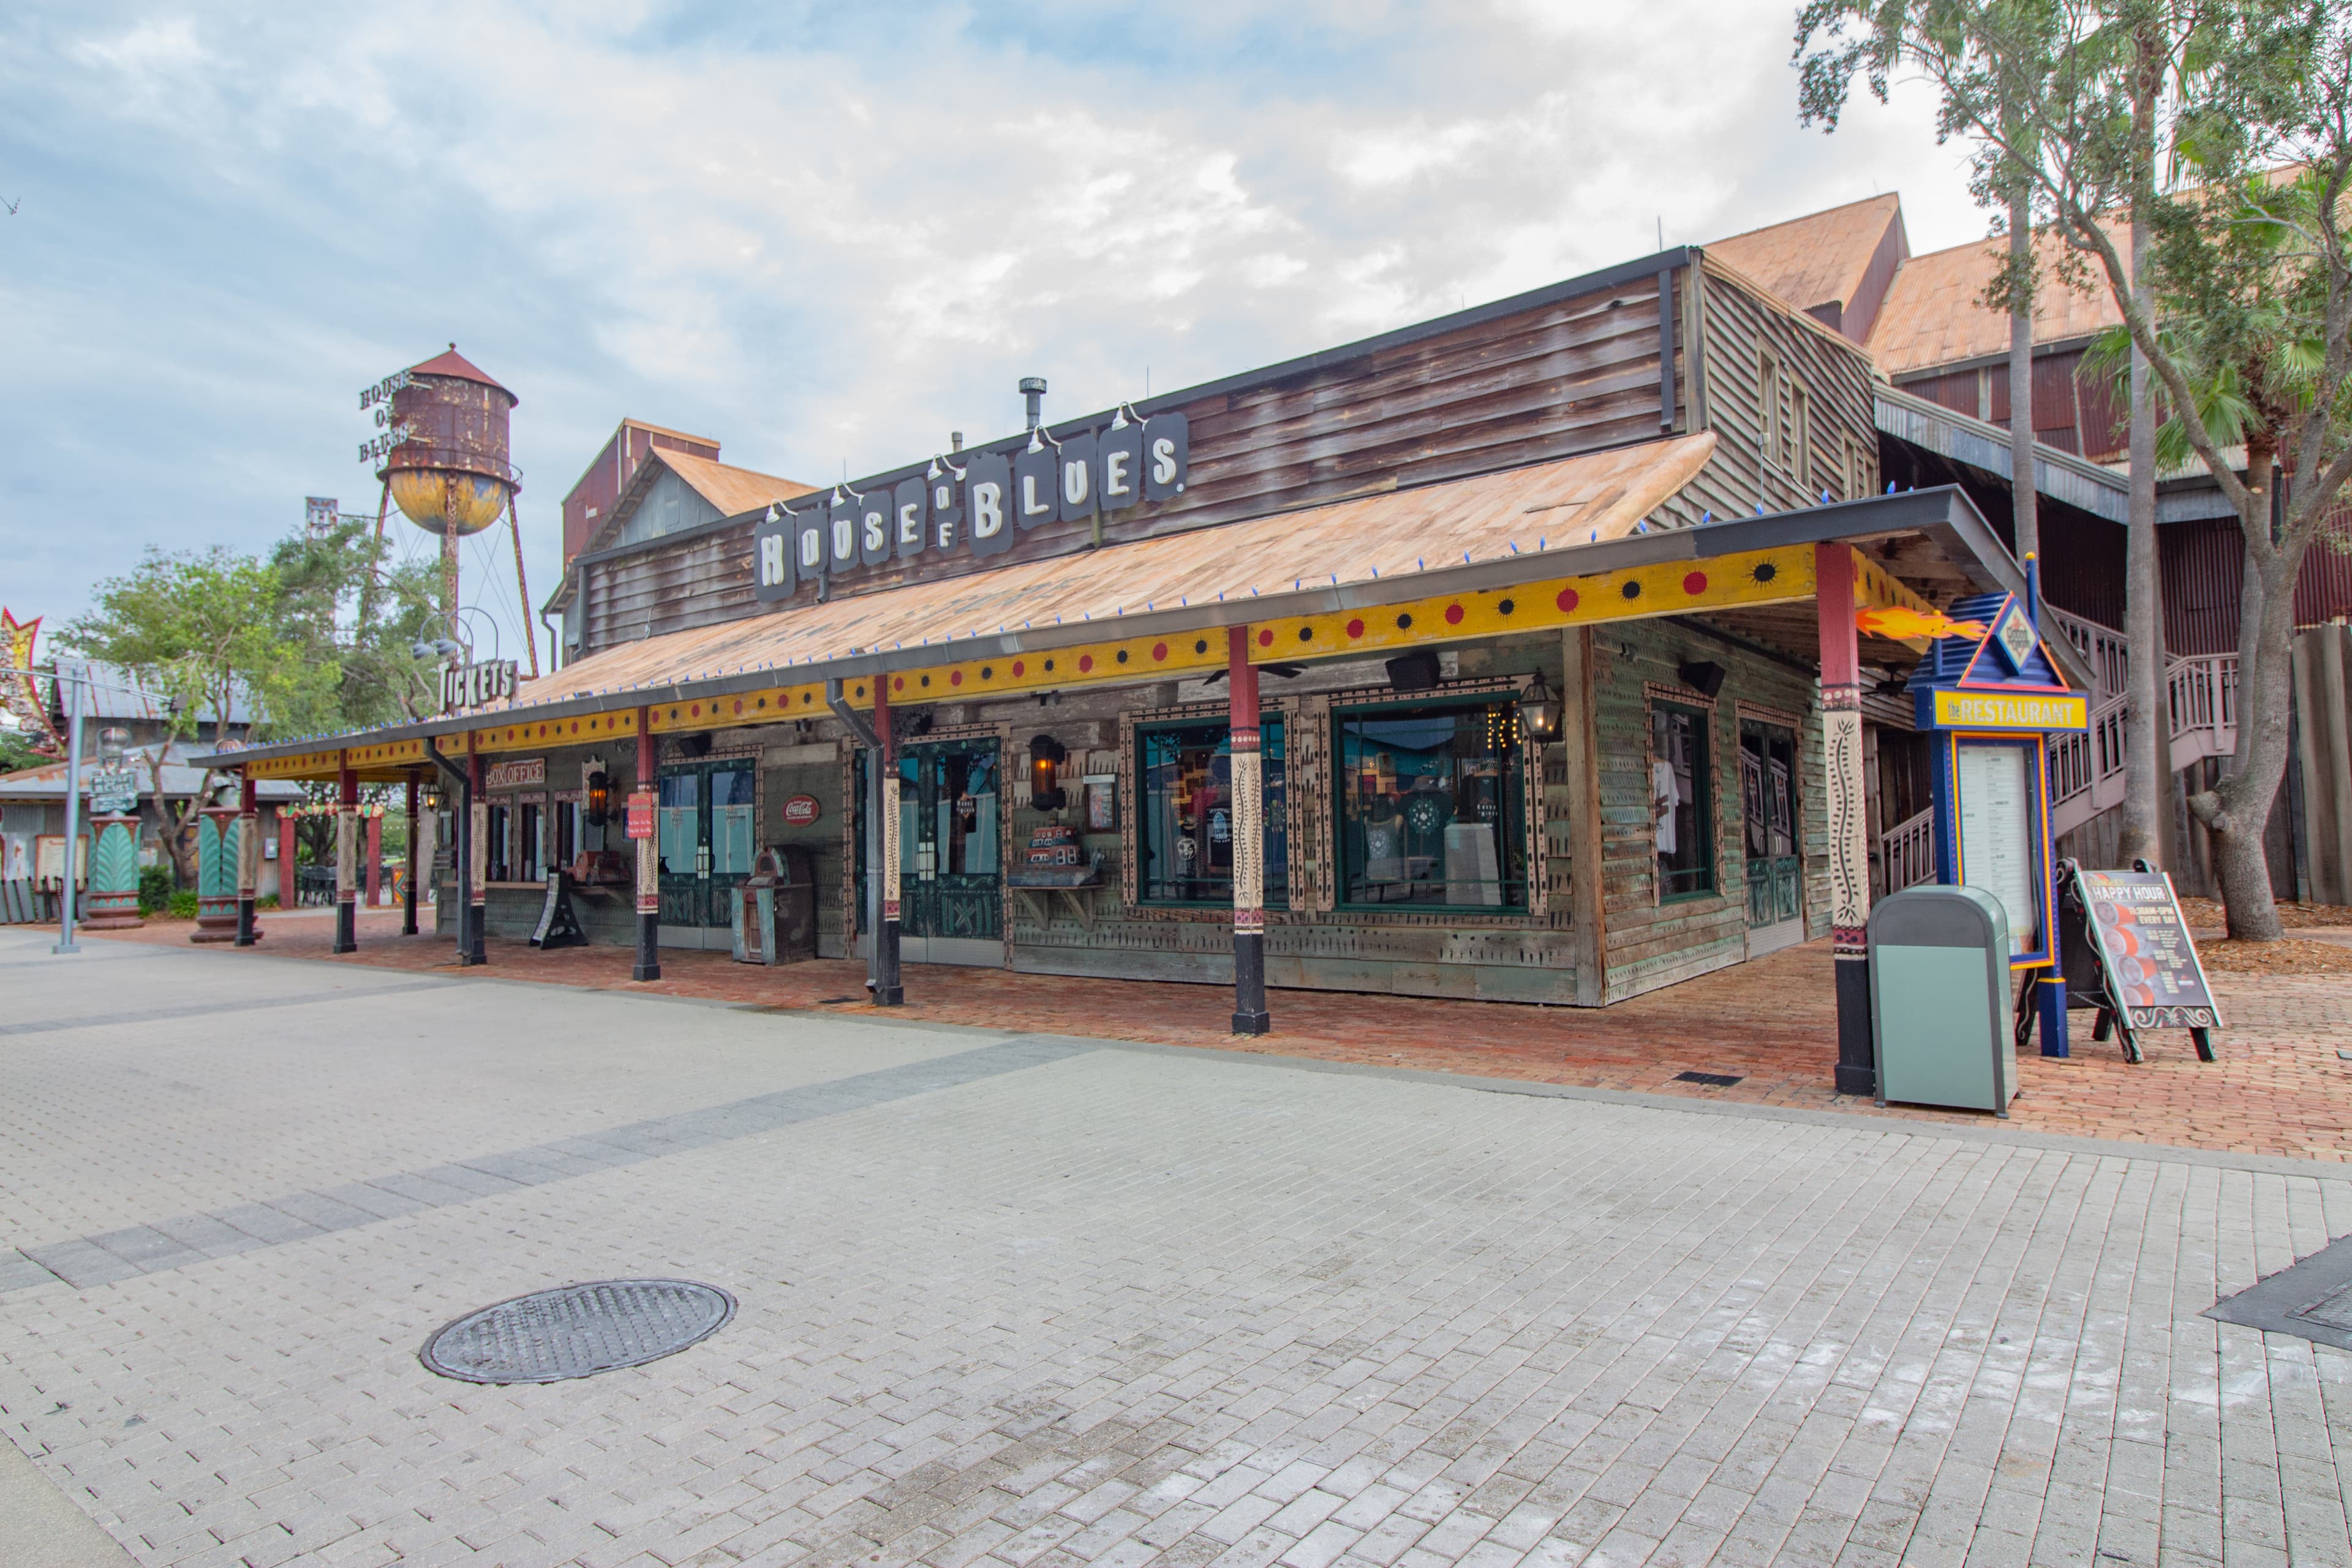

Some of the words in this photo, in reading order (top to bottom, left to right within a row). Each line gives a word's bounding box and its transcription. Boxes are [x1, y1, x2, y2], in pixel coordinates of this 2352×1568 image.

[360, 368, 410, 410] HOUSE
[360, 422, 409, 462] BLUES
[761, 503, 919, 587] HOUSE
[936, 487, 954, 548] OF
[973, 438, 1177, 539] BLUES
[438, 662, 513, 711] TICKETS
[1948, 701, 1959, 721] the
[1961, 699, 2073, 724] RESTAURANT
[486, 768, 505, 785] BOX
[507, 764, 543, 782] OFFICE
[2092, 886, 2132, 900] HAPPY
[2132, 886, 2166, 900] HOUR
[2138, 916, 2162, 924] EVERY
